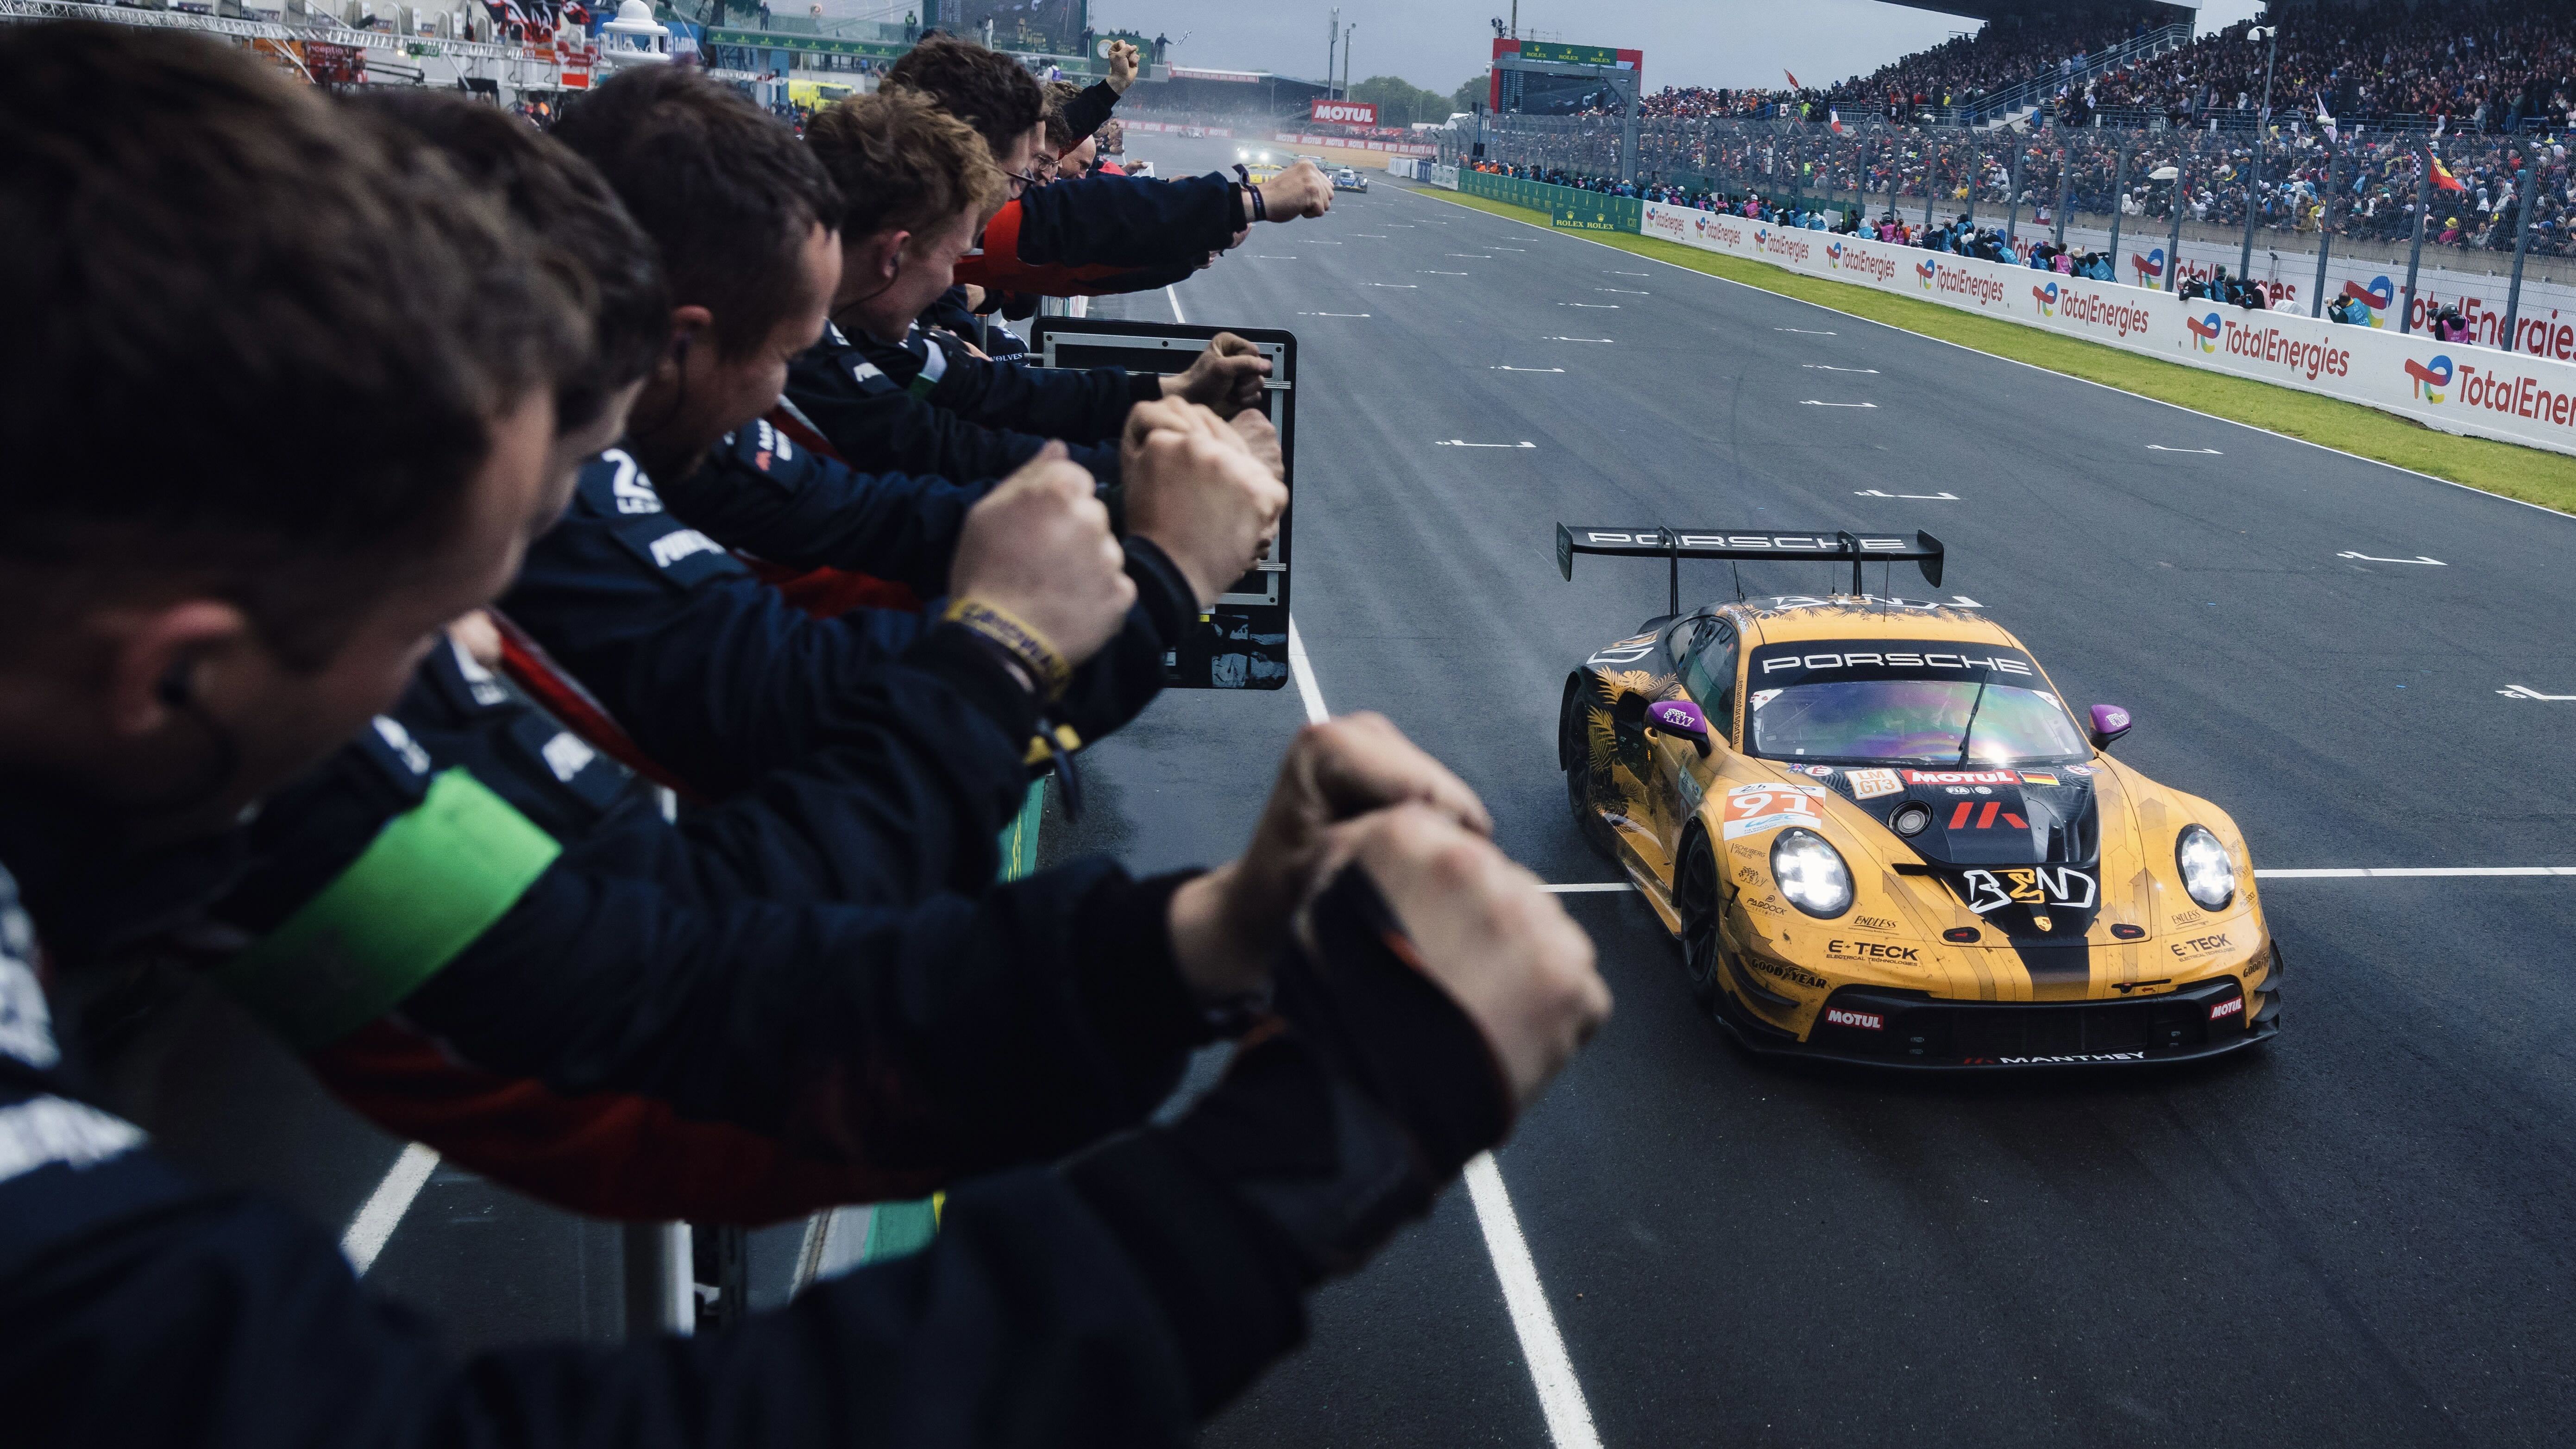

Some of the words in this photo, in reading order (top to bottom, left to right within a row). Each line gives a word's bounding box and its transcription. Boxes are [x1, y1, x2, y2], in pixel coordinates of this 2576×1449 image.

[1314, 105, 1374, 123] MOTUL
[1301, 136, 1322, 145] MOTUL
[1326, 138, 1345, 147] MOTUL
[1348, 140, 1365, 149] MOTUL
[1655, 210, 1684, 235] TotalEnergies
[1706, 220, 1741, 248] TotalEnergies
[1767, 232, 1809, 263] TotalEnergies
[1842, 246, 1896, 282] TotalEnergies
[1936, 264, 2004, 306] TotalEnergies
[2061, 288, 2149, 338] TotalEnergies
[2225, 320, 2350, 381] TotalEnergies
[1763, 652, 2032, 676] PORSCHE
[1856, 771, 1886, 780] LM
[1912, 772, 2014, 783] MOTUL
[1859, 779, 1896, 794] GT3
[1733, 793, 1816, 818] 91
[1734, 844, 1766, 858] SCHUBERG
[1734, 849, 1753, 859] PHILIS
[1747, 897, 1788, 916] PADDOCK
[1853, 915, 1899, 928] ENDLESS
[2171, 909, 2201, 924] ENDLESS
[1867, 957, 1918, 967] TECHNOLOGIES
[2178, 953, 2205, 962] ELECTRICAL
[2205, 947, 2236, 956] TECHNOLOGIES
[2212, 998, 2242, 1018] MOTUL
[1828, 1010, 1881, 1029] MOTUL
[1999, 1051, 2144, 1064] MANTHEY
